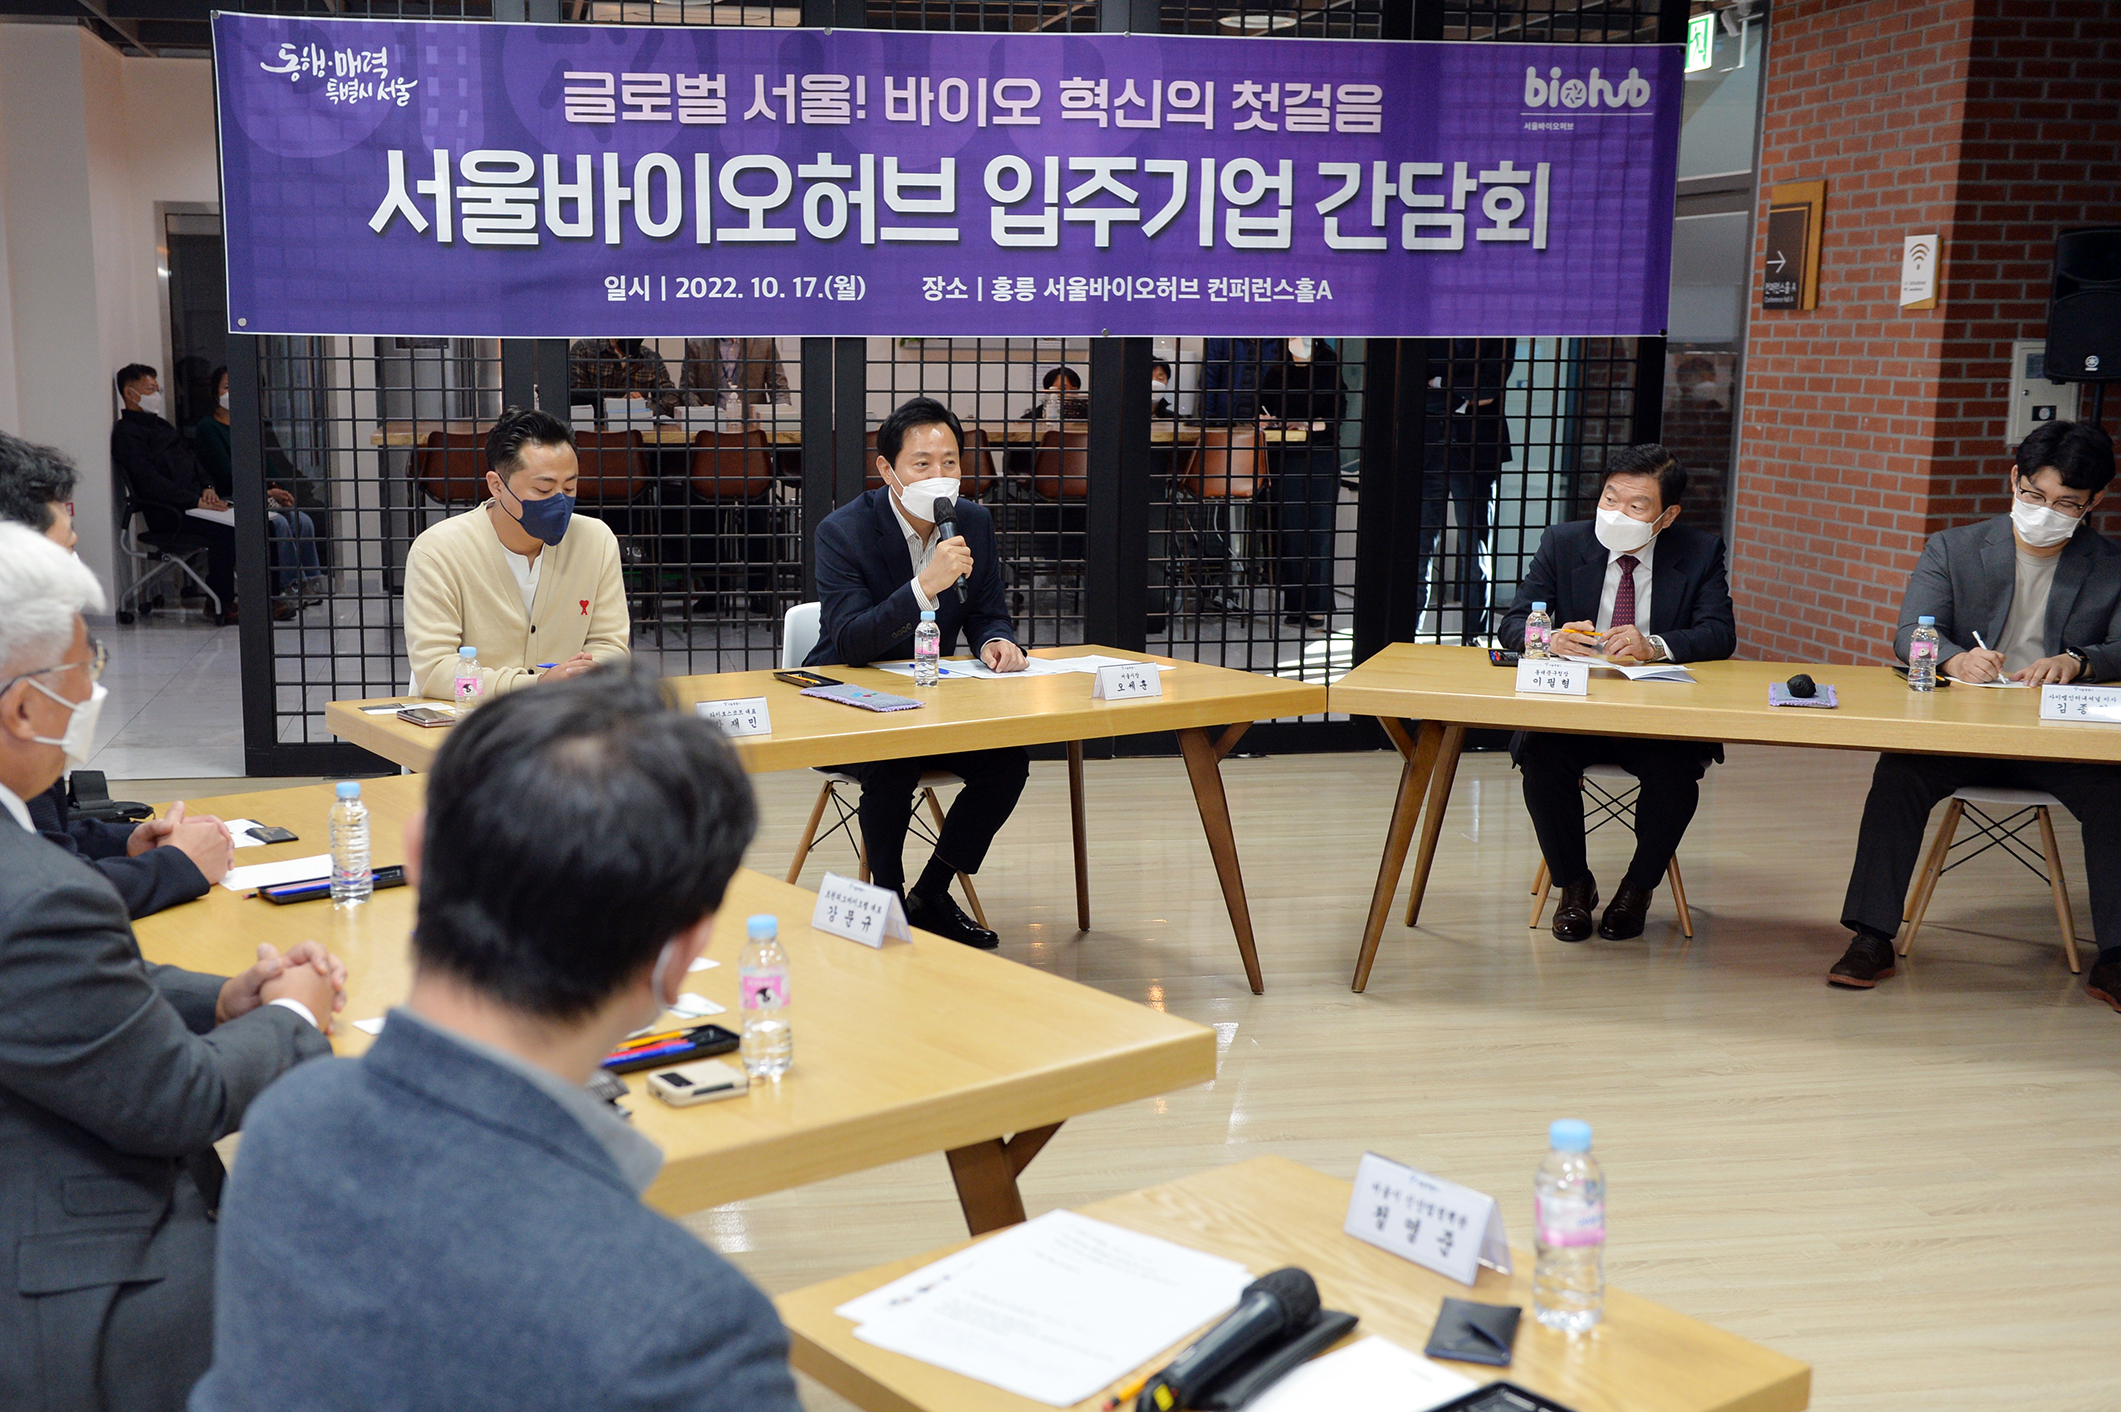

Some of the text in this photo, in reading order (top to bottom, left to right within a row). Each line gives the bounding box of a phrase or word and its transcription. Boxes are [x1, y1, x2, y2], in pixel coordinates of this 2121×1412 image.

[325, 77, 419, 107] 특별시 서울
[563, 71, 1384, 133] 글로벌 서울! 바이오 혁신의 첫걸음
[1524, 66, 1651, 108] biohub
[1524, 122, 1575, 131] 서울바이오허브
[367, 148, 1551, 251] 서울바이오허브 입주기업 간담회
[604, 274, 866, 302] 일시 2022. 10. 17.(월)
[921, 275, 1333, 303] 장소 홍릉 서울바이오허브 컨퍼런스홀A
